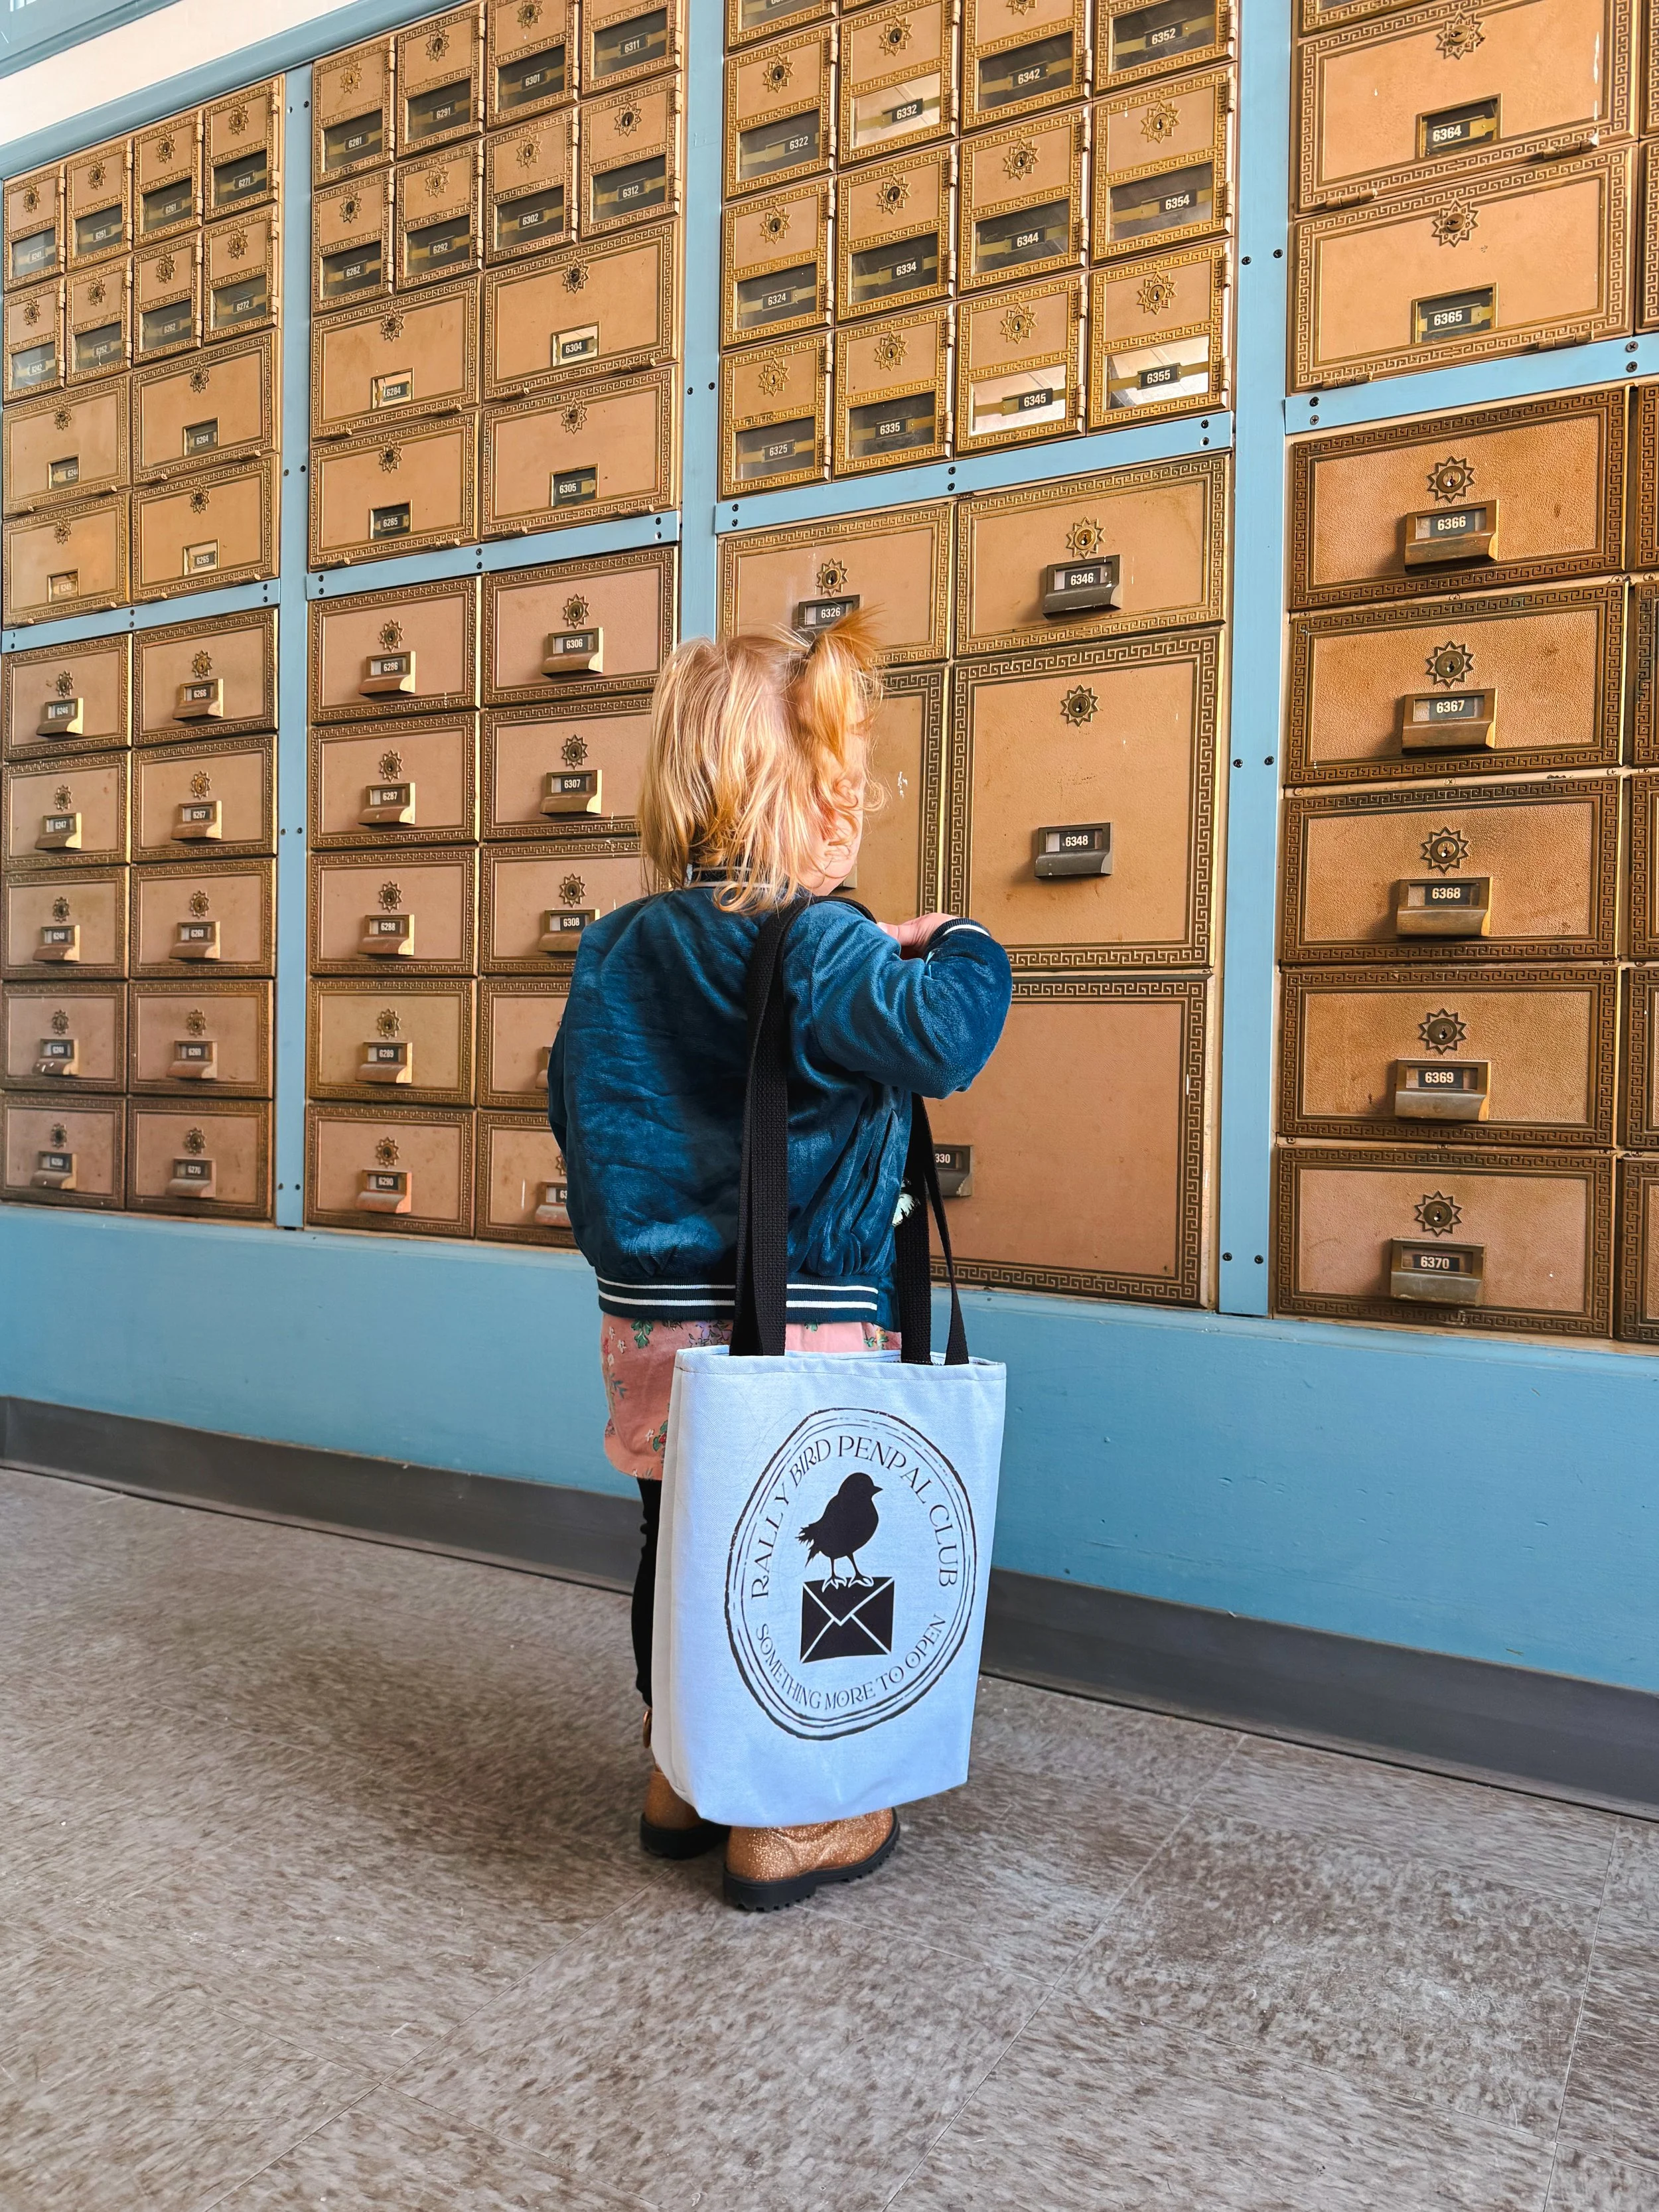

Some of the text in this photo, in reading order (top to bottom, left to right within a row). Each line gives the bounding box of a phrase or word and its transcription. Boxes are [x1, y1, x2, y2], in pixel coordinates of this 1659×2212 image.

[1152, 28, 1175, 44] 6352
[624, 40, 640, 53] 6311
[526, 74, 540, 86] 6301
[1018, 68, 1040, 84] 6342
[437, 107, 451, 119] 6291
[897, 104, 917, 119] 6332
[1433, 125, 1462, 142] 6364
[348, 137, 362, 148] 6281
[790, 136, 808, 149] 6322
[238, 177, 251, 188] 6271
[622, 185, 638, 198] 6312
[1165, 194, 1190, 210] 6354
[165, 203, 176, 214] 6261
[522, 213, 538, 226] 6302
[1017, 232, 1039, 247] 6344
[433, 242, 448, 254] 6292
[346, 265, 360, 277] 6282
[897, 261, 916, 275] 6334
[237, 300, 250, 311] 6272
[768, 293, 786, 306] 6324
[1434, 310, 1463, 326] 6365
[565, 342, 582, 354] 6304
[1147, 370, 1171, 384] 6355
[386, 386, 401, 397] 6284
[1024, 393, 1046, 407] 6345
[880, 422, 900, 435] 6335
[769, 444, 788, 456] 6325
[559, 483, 577, 494] 6305
[383, 517, 397, 528] 6285
[1437, 516, 1466, 530] 6366
[196, 555, 209, 565] 6265
[1070, 573, 1094, 585] 6346
[821, 607, 840, 619] 6326
[566, 638, 583, 649] 6306
[384, 662, 398, 672] 6286
[1437, 700, 1465, 713] 6367
[564, 779, 581, 788] 6307
[383, 791, 397, 801] 6287
[193, 810, 206, 819] 6267
[1066, 835, 1088, 847] 6348
[1432, 887, 1461, 899] 6368
[381, 922, 396, 931] 6288
[563, 917, 580, 927] 6308
[1425, 1072, 1454, 1083] 6369
[935, 1153, 950, 1163] 330
[1421, 1256, 1449, 1269] 6370
[751, 1435, 959, 1600] RALLY BIRD PENPAL CLUB
[755, 1614, 947, 1710] SOMETHING MORE TO OPEN
